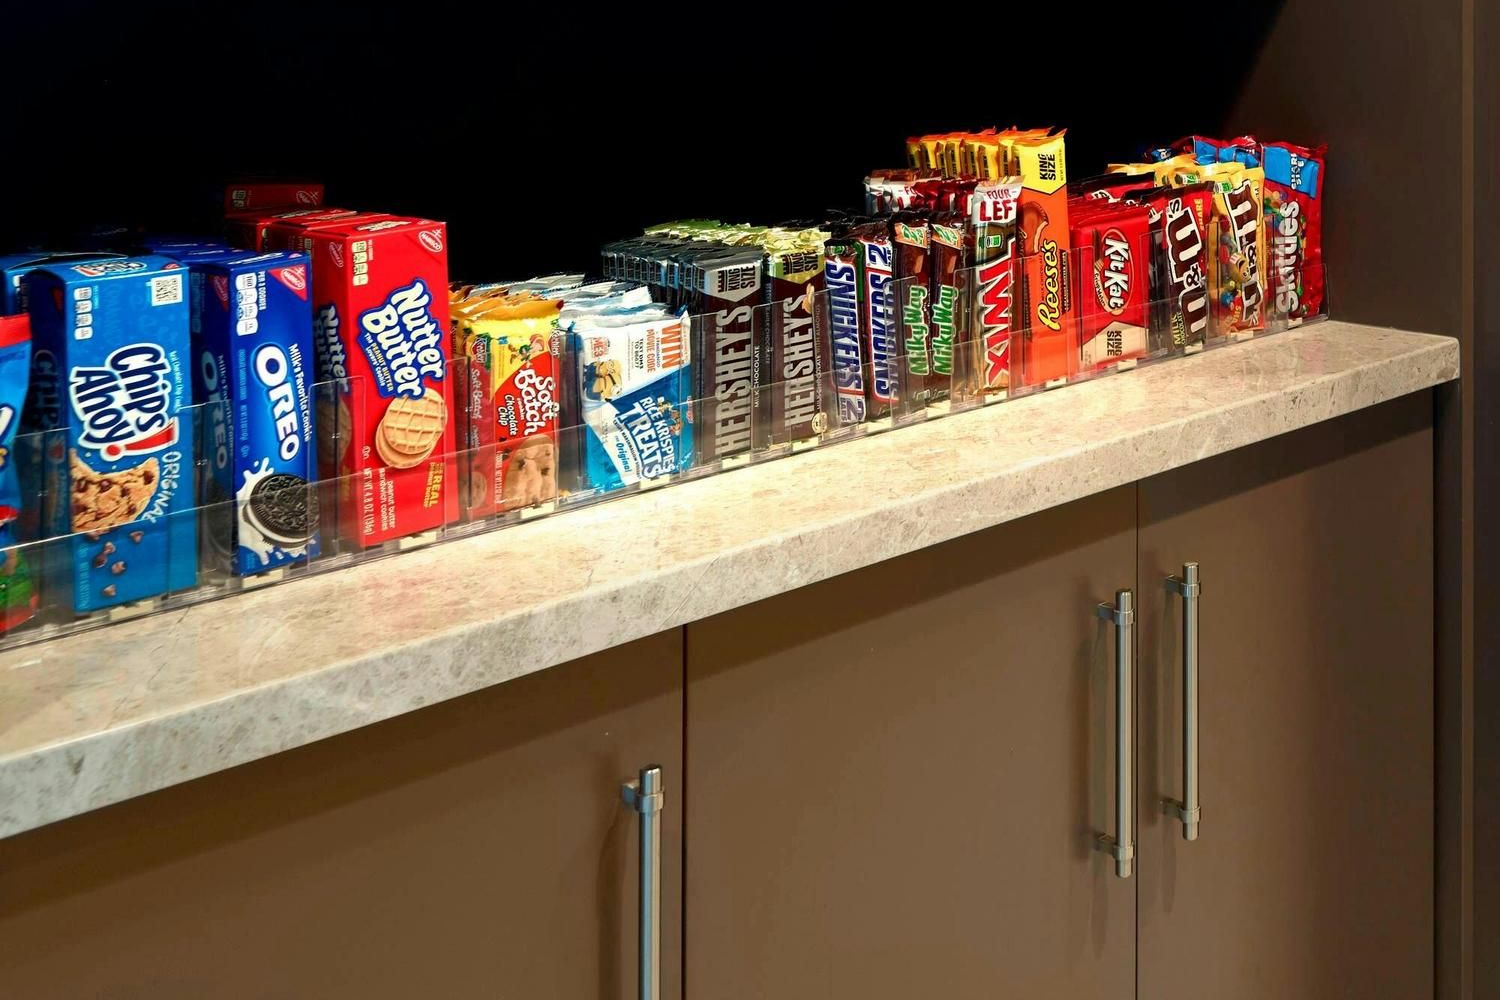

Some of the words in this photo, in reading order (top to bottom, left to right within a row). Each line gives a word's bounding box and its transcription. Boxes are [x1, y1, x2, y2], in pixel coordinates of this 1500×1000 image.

[1039, 153, 1048, 180] KING
[1047, 154, 1056, 180] SIZE
[728, 267, 741, 291] KING
[740, 265, 756, 289] SIZE
[1276, 201, 1299, 313] Skittles
[904, 286, 928, 326] Way
[932, 286, 958, 327] Way
[1038, 238, 1061, 331] Reese's
[391, 282, 445, 380] Nutter
[646, 328, 655, 353] MOVIE
[661, 323, 681, 369] WIN
[825, 260, 863, 390] SNICKERS
[905, 323, 929, 375] Milky
[1107, 330, 1115, 356] SIZE
[1114, 330, 1122, 356] KING
[1171, 314, 1181, 345] MILK
[362, 304, 422, 397] Butter
[372, 342, 386, 366] PEANUT
[382, 367, 394, 392] BUTTER
[646, 353, 655, 372] CODE
[783, 294, 815, 428] HERSHEY'S
[932, 325, 956, 375] Milky
[109, 346, 168, 433] Chips
[288, 343, 301, 372] Milk's
[295, 371, 308, 410] Favorite
[533, 376, 559, 420] Soft
[714, 305, 752, 456] HERSHEY'S
[256, 345, 300, 461] OREO
[498, 406, 508, 426] Chip
[505, 394, 518, 436] Chocolate
[514, 368, 546, 436] Batch
[616, 442, 633, 473] Original
[617, 402, 663, 479] TREATS
[640, 396, 664, 420] RICE
[654, 420, 676, 473] KRISPIES
[142, 451, 182, 524] ORIGINAL
[430, 474, 444, 506] REAL
